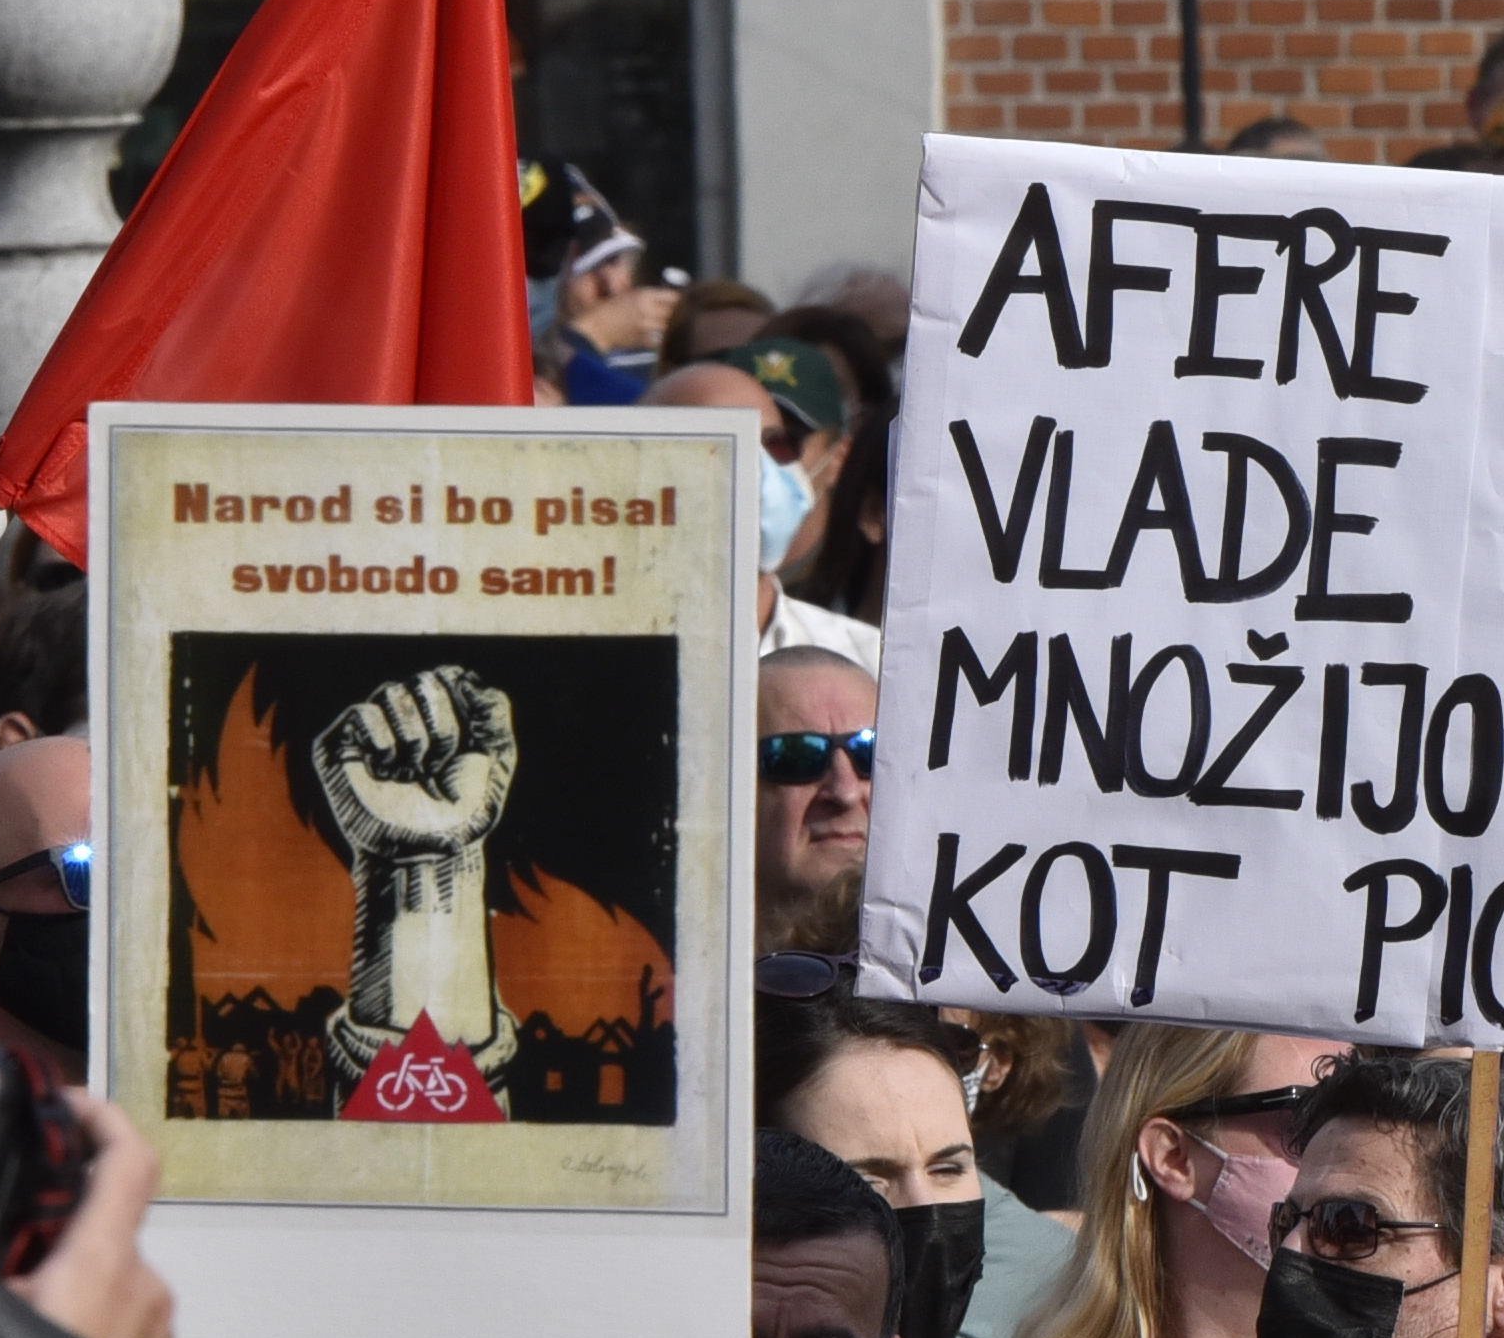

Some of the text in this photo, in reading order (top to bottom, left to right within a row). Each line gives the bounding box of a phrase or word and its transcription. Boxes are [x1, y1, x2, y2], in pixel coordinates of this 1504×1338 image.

[957, 183, 1450, 404] AFERE
[173, 483, 676, 536] Narod si bo pisal
[231, 555, 616, 596] svobodo sam!
[949, 416, 1413, 623] VLADE
[928, 626, 1504, 837] MNOŽIJO
[919, 833, 1241, 1008] KOT
